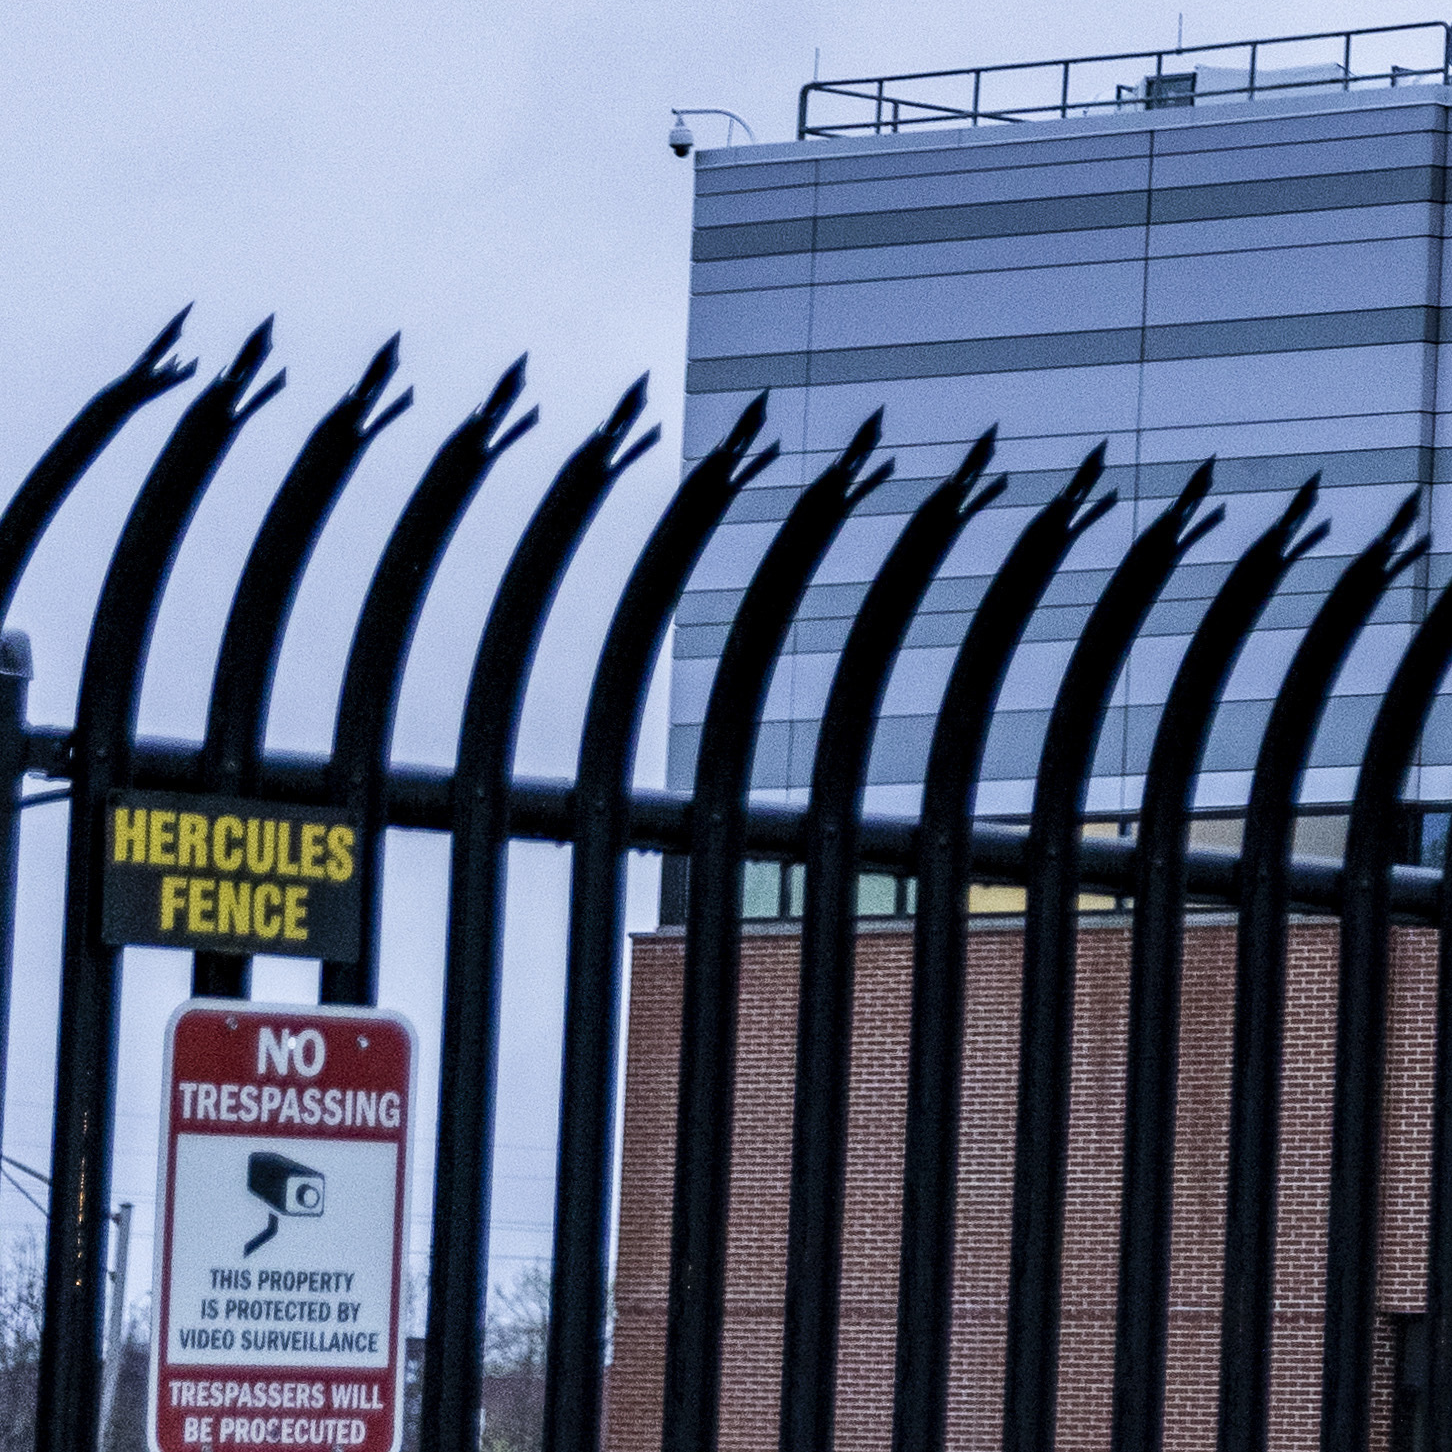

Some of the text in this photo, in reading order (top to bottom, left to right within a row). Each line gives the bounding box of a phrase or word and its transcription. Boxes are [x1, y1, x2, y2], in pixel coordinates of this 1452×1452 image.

[113, 807, 356, 883] HERCULES
[159, 875, 309, 941] FENCE
[256, 1026, 326, 1078] NO
[178, 1081, 400, 1128] TRESPASSING
[210, 1268, 354, 1293] THIS PROPERTY
[201, 1299, 361, 1324] IS PROTECTED BY
[179, 1328, 379, 1353] VIDEO SURVEILLANCE
[168, 1381, 384, 1410] TRESPASSERS WILL
[183, 1417, 367, 1445] BE PROSECUTED
